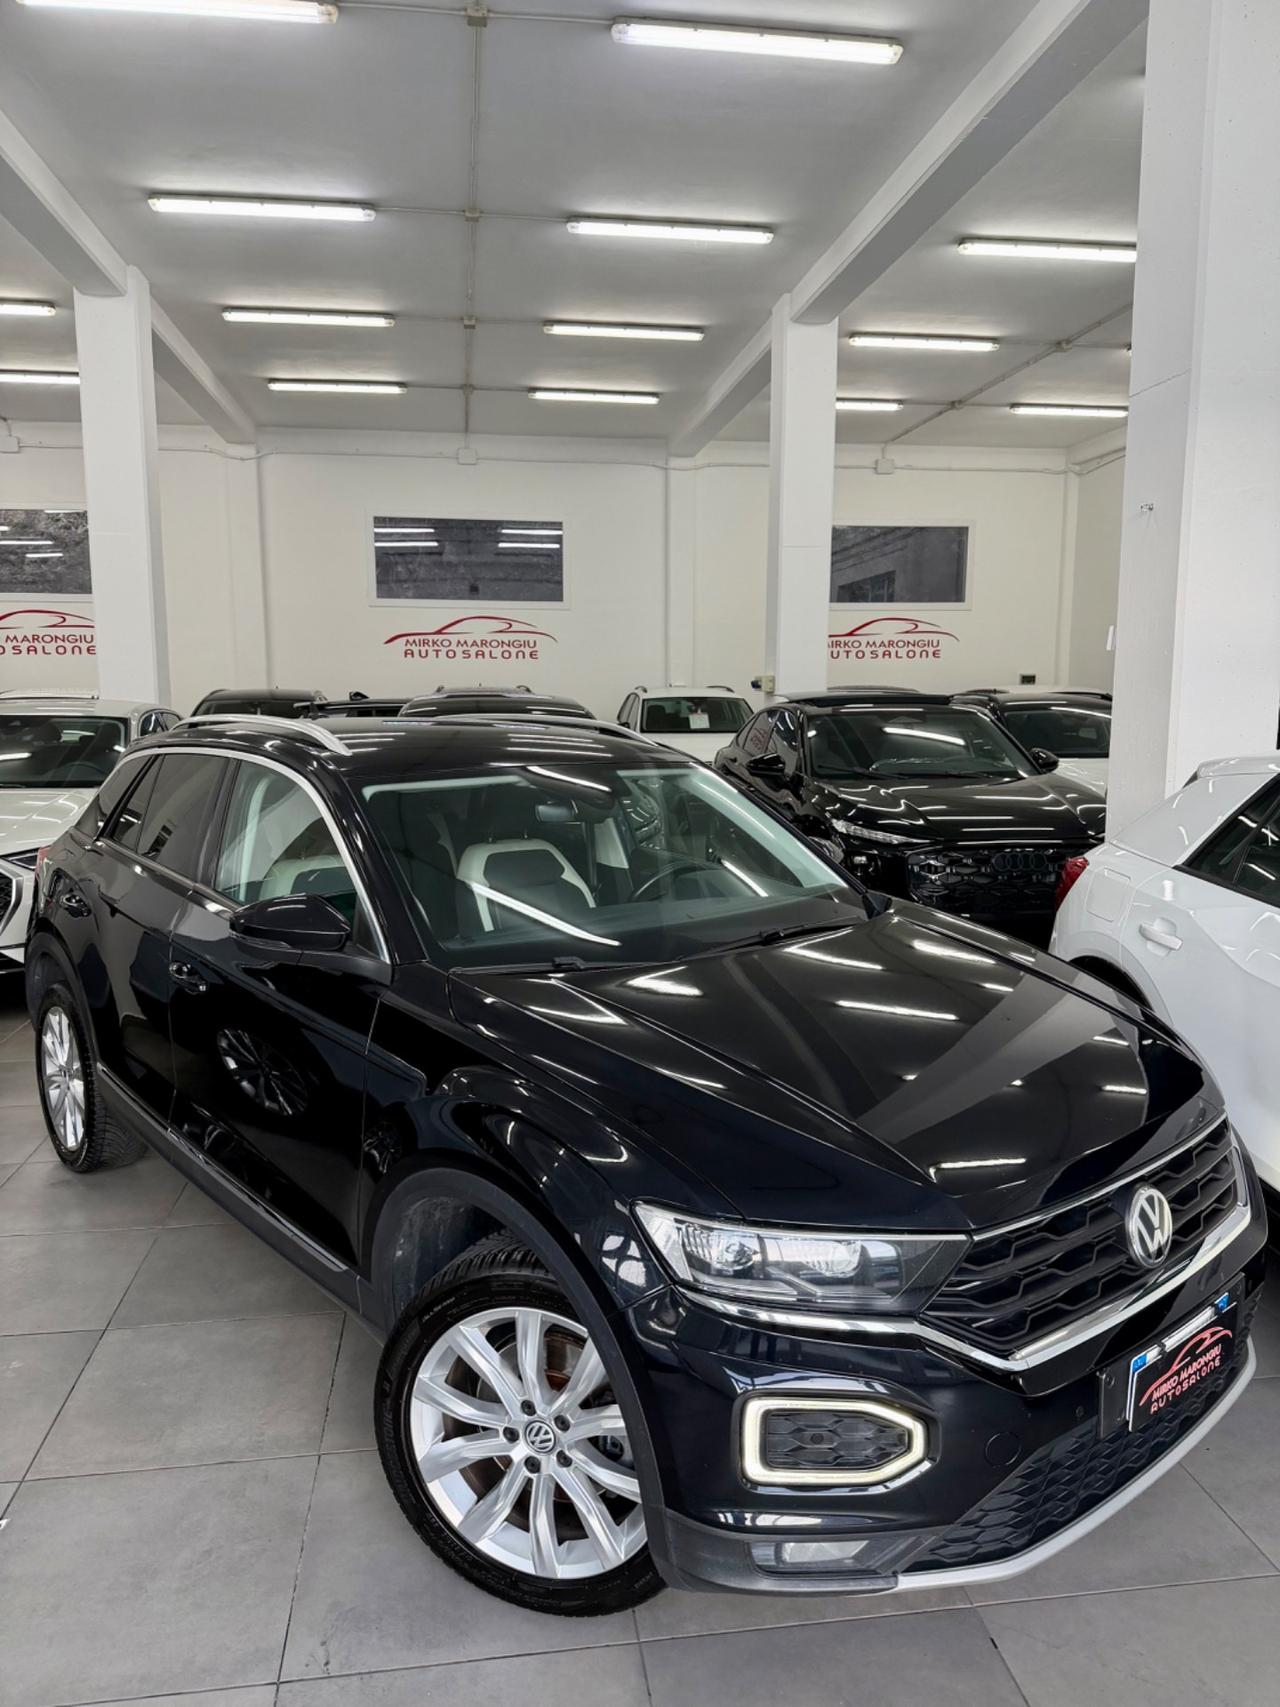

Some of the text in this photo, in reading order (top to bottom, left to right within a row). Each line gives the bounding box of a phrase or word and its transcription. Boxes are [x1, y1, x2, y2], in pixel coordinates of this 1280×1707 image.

[5, 634, 94, 644] MARONGIU
[405, 639, 537, 649] MIRKO MARONGIU
[828, 640, 940, 649] IRKO MARONGIU
[404, 649, 539, 660] AUTOSALONE
[828, 649, 941, 659] UTOSALONE
[1151, 1343, 1222, 1402] MIRKO MARONGIU
[1150, 1356, 1222, 1414] AUTOSALONE
